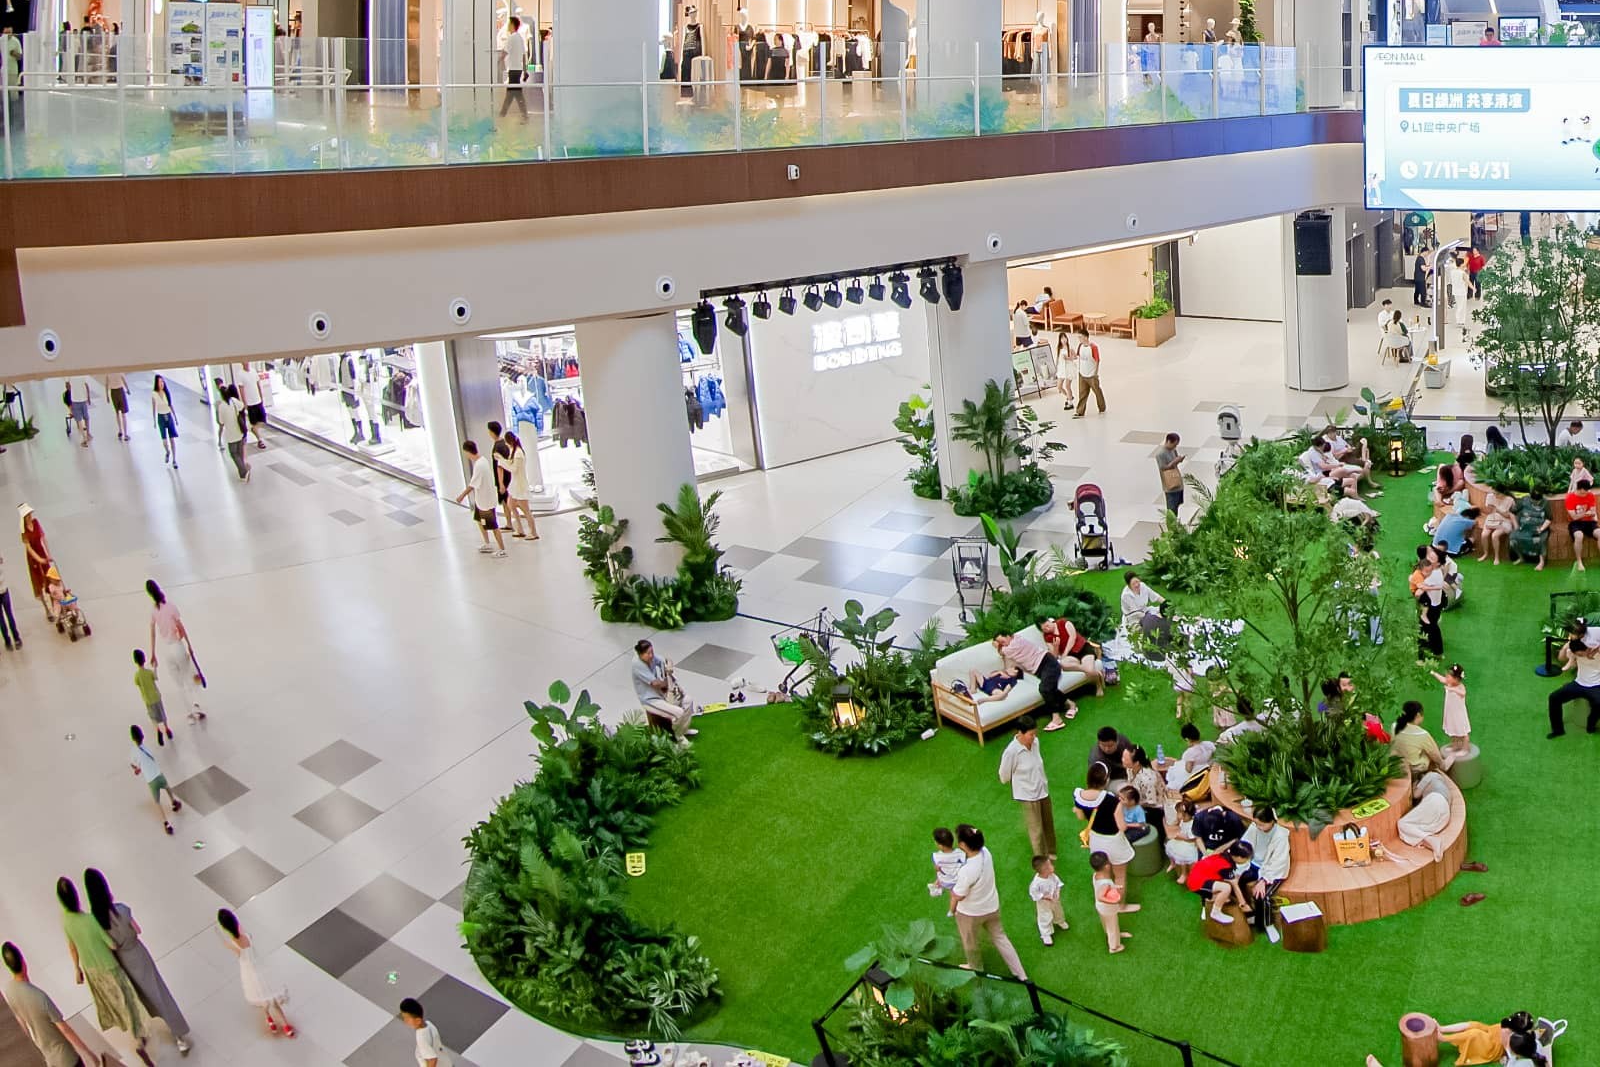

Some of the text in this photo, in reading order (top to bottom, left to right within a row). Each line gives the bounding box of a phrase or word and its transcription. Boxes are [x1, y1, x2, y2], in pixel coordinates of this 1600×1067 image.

[1412, 121, 1480, 133] L1层中央广场
[1422, 160, 1512, 180] 7/11-8/31
